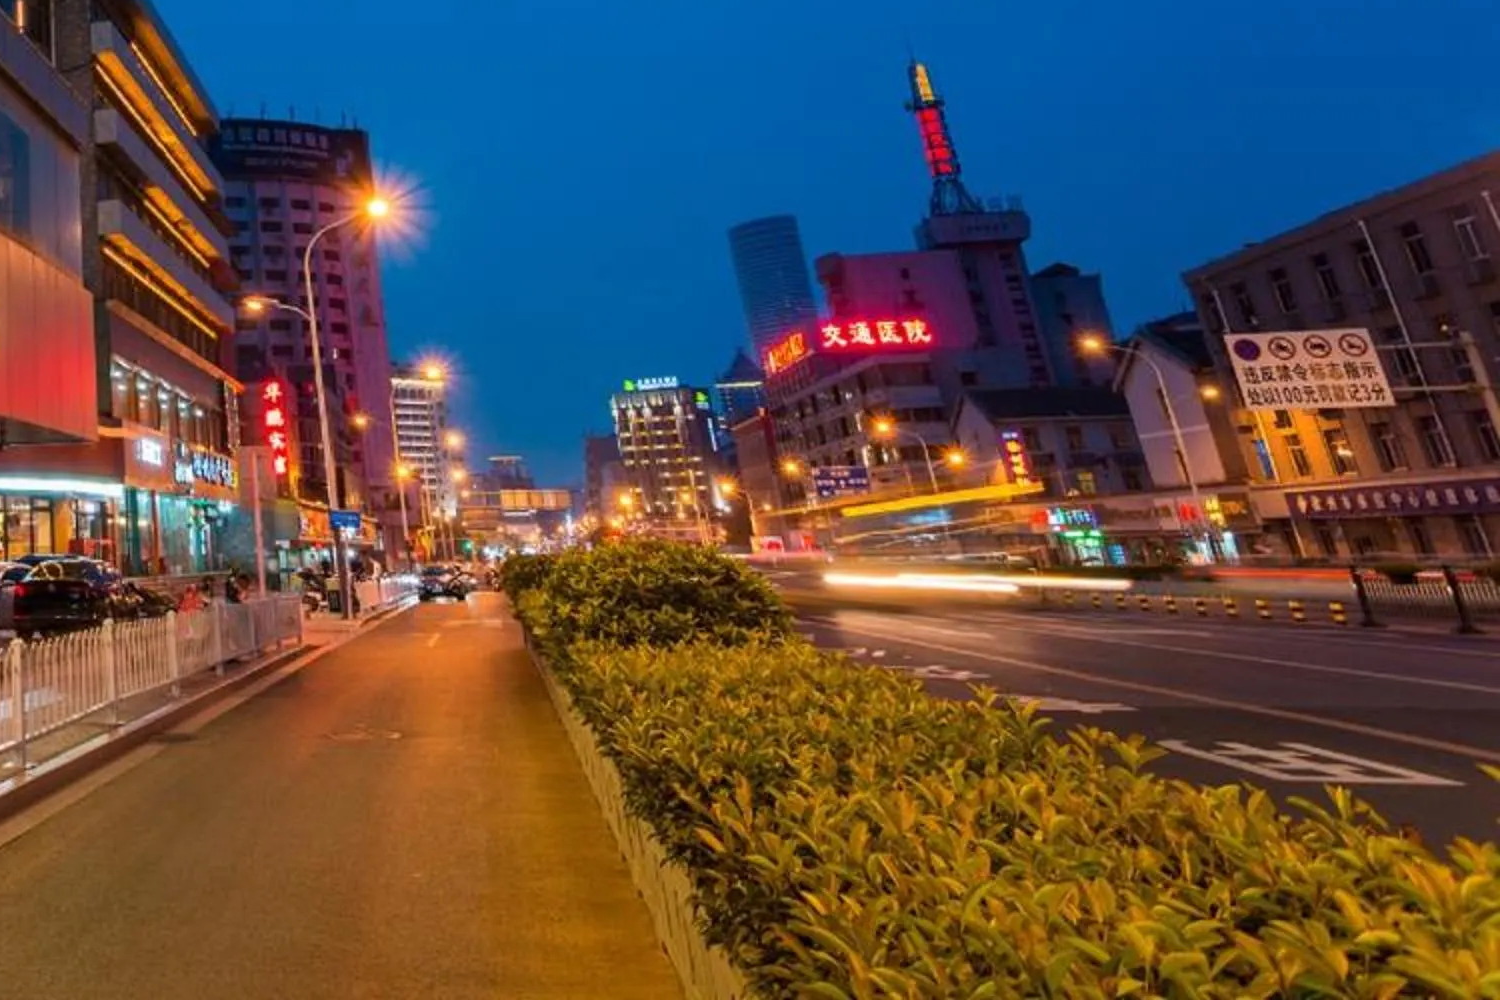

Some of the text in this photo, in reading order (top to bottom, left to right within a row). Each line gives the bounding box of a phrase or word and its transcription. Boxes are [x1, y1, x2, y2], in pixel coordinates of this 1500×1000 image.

[821, 319, 932, 348] 交通医院
[1241, 361, 1378, 384] 违反禁令标志指示
